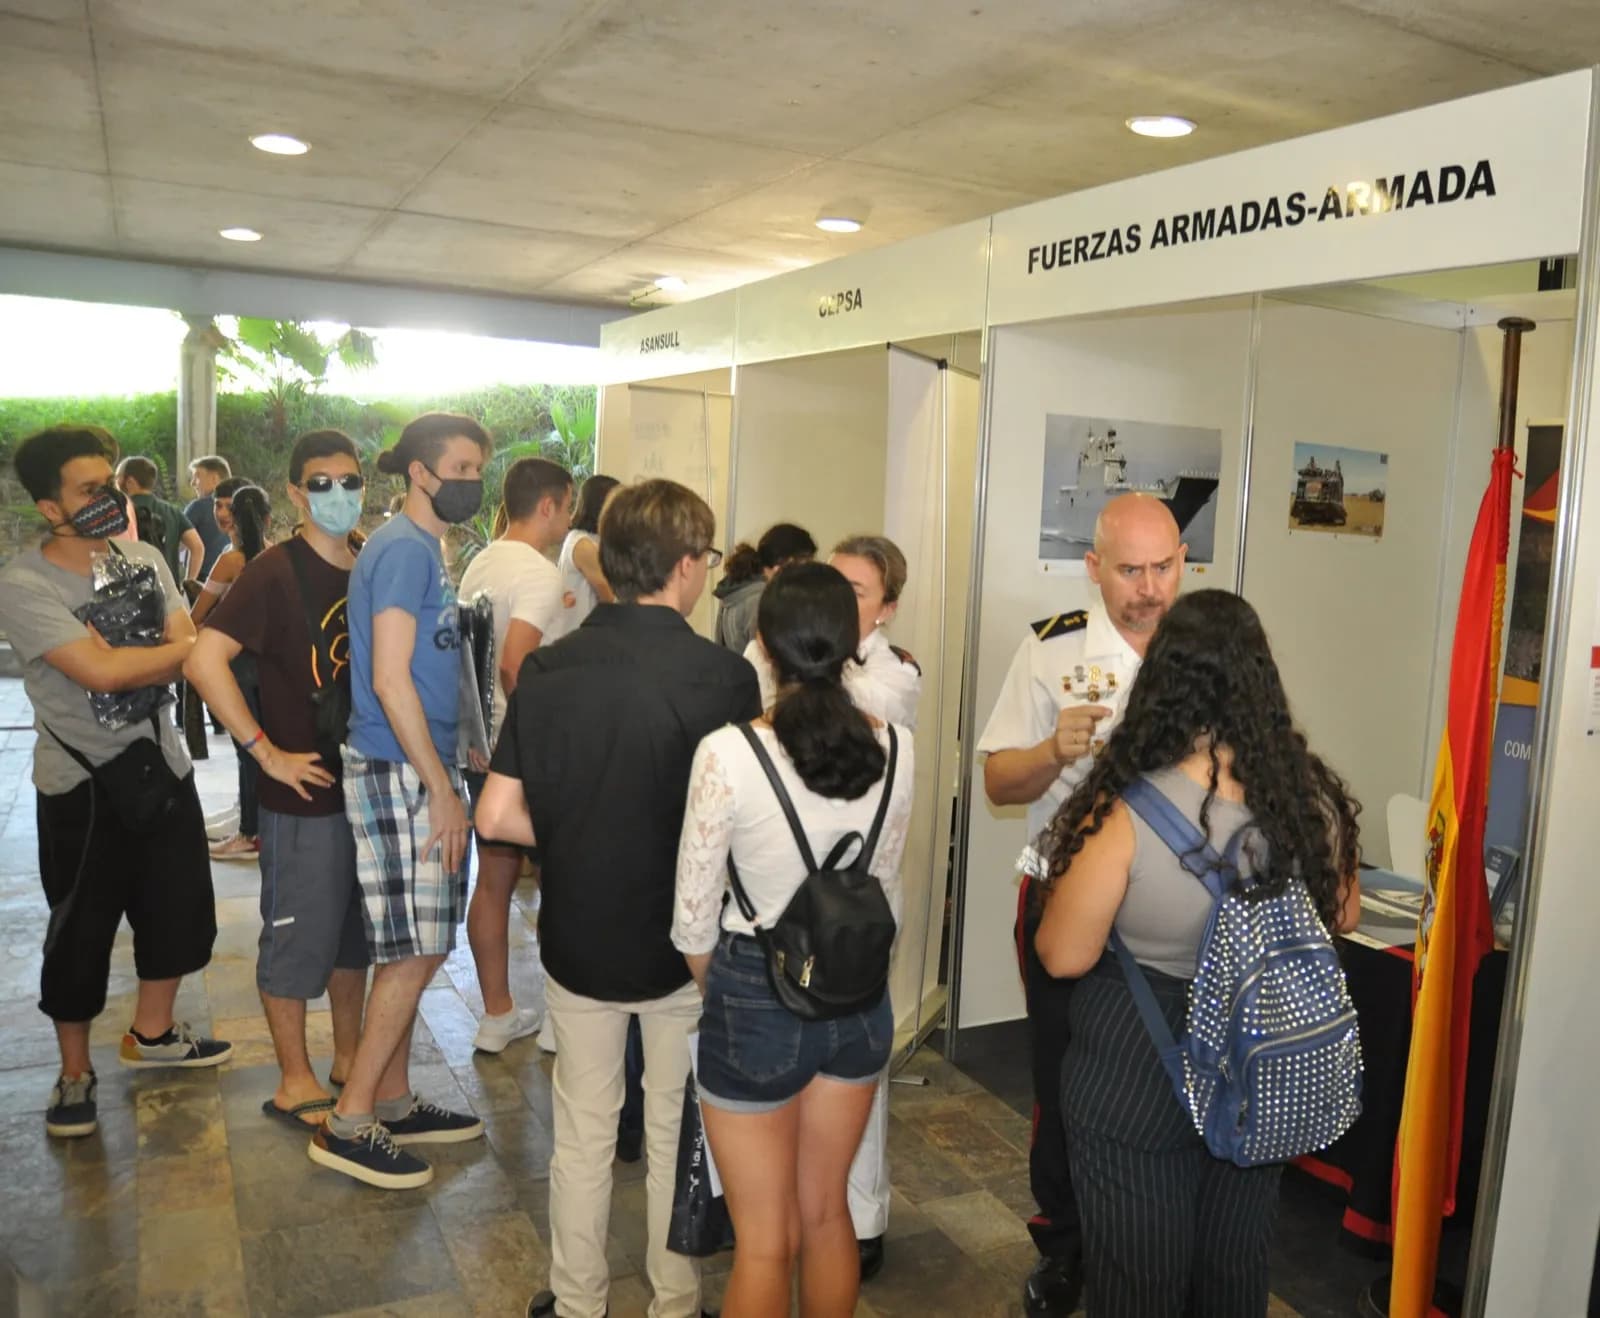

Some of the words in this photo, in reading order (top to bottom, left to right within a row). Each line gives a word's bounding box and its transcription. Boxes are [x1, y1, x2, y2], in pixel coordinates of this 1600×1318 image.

[1028, 223, 1142, 274] FUERZAS
[1150, 159, 1497, 249] ARMADAS-ARMADA
[639, 330, 680, 355] ASANSULL
